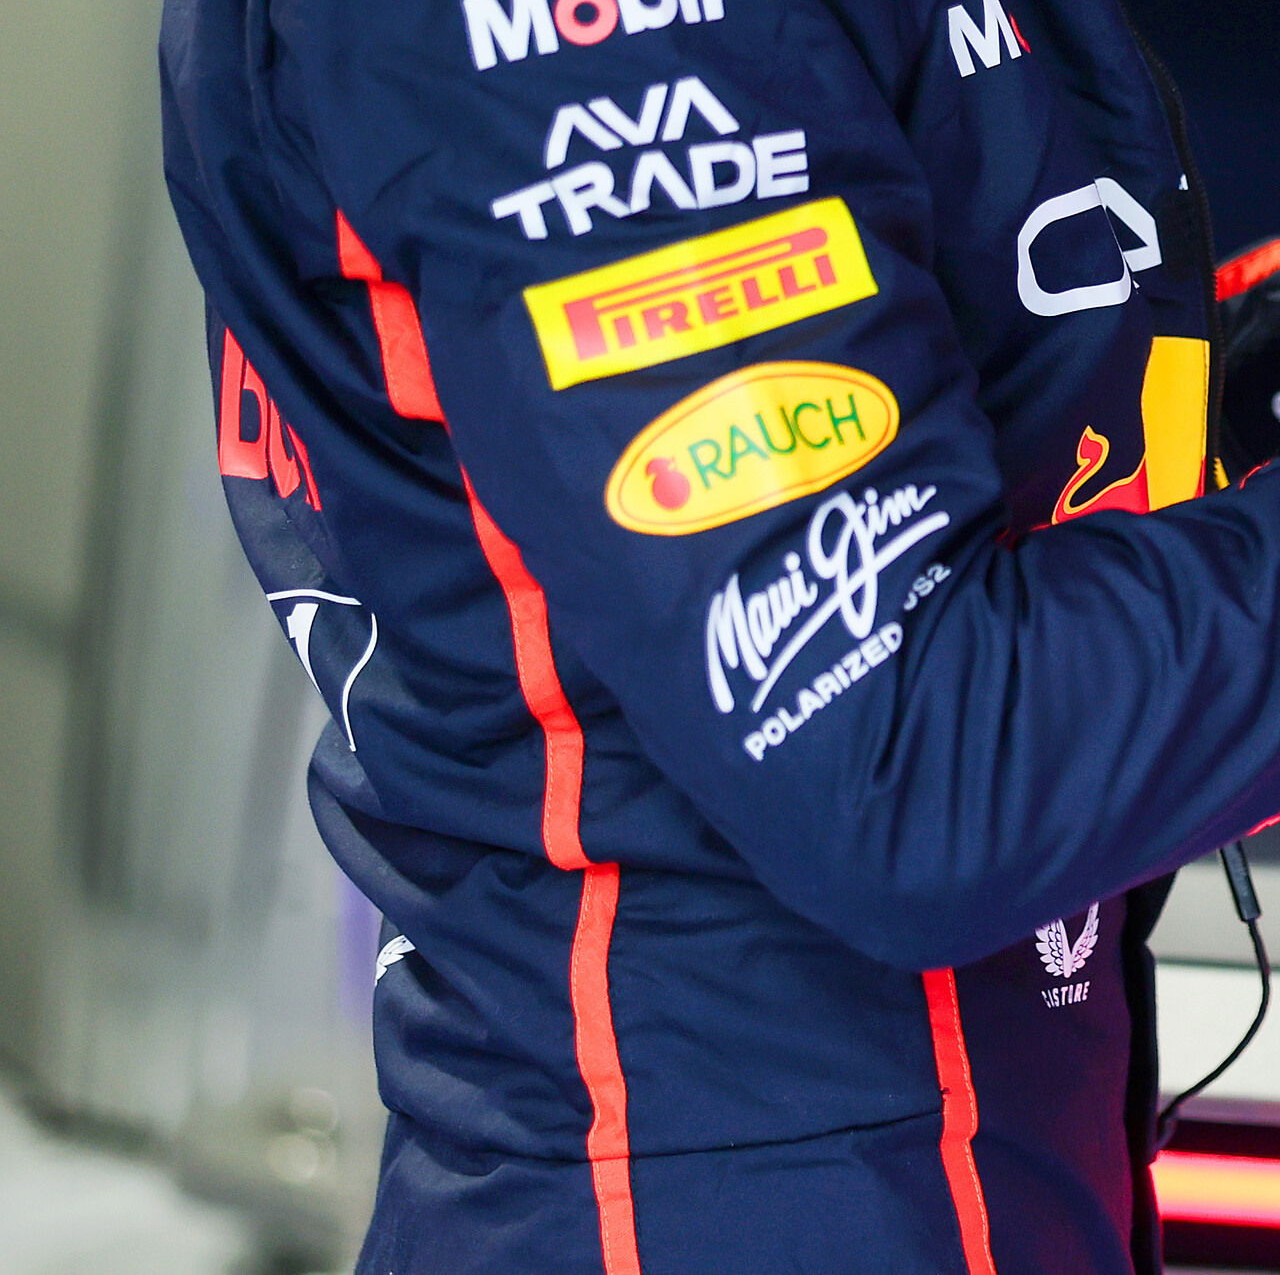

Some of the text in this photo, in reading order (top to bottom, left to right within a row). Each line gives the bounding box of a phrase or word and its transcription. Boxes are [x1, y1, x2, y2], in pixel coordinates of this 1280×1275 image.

[545, 76, 740, 170] AVA
[491, 130, 809, 240] TRADE
[562, 226, 837, 362] PIRELLI
[686, 392, 867, 492] RAUCH
[705, 484, 938, 715] Maui Jim
[743, 620, 904, 763] POLARIZED
